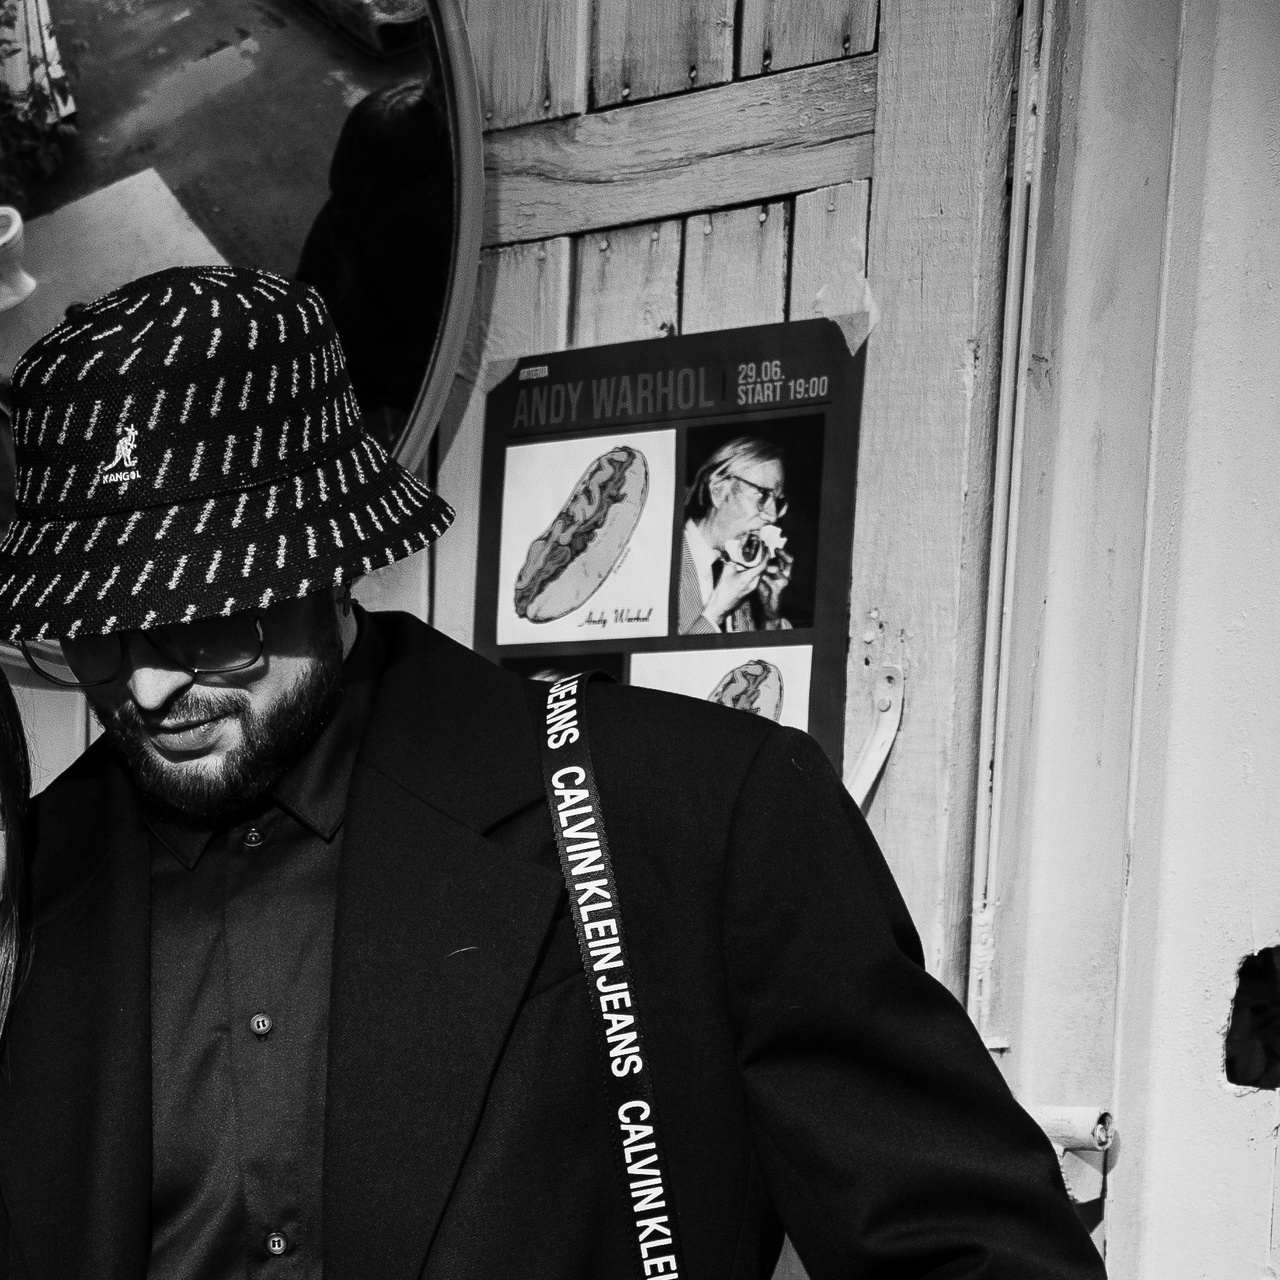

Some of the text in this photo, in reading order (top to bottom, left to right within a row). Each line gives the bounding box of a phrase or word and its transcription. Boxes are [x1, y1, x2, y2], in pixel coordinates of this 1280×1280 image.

[513, 367, 715, 429] ANDY WARHOL
[737, 361, 785, 384] 29.06.
[737, 376, 829, 406] START 19:00
[103, 470, 142, 485] KANGOL
[577, 607, 654, 629] Andy Warhol
[546, 679, 580, 750] JEANS
[551, 765, 604, 876] CALVIN
[574, 878, 625, 972] KLEIN
[596, 975, 643, 1078] JEANS
[617, 1100, 666, 1213] CALVIN
